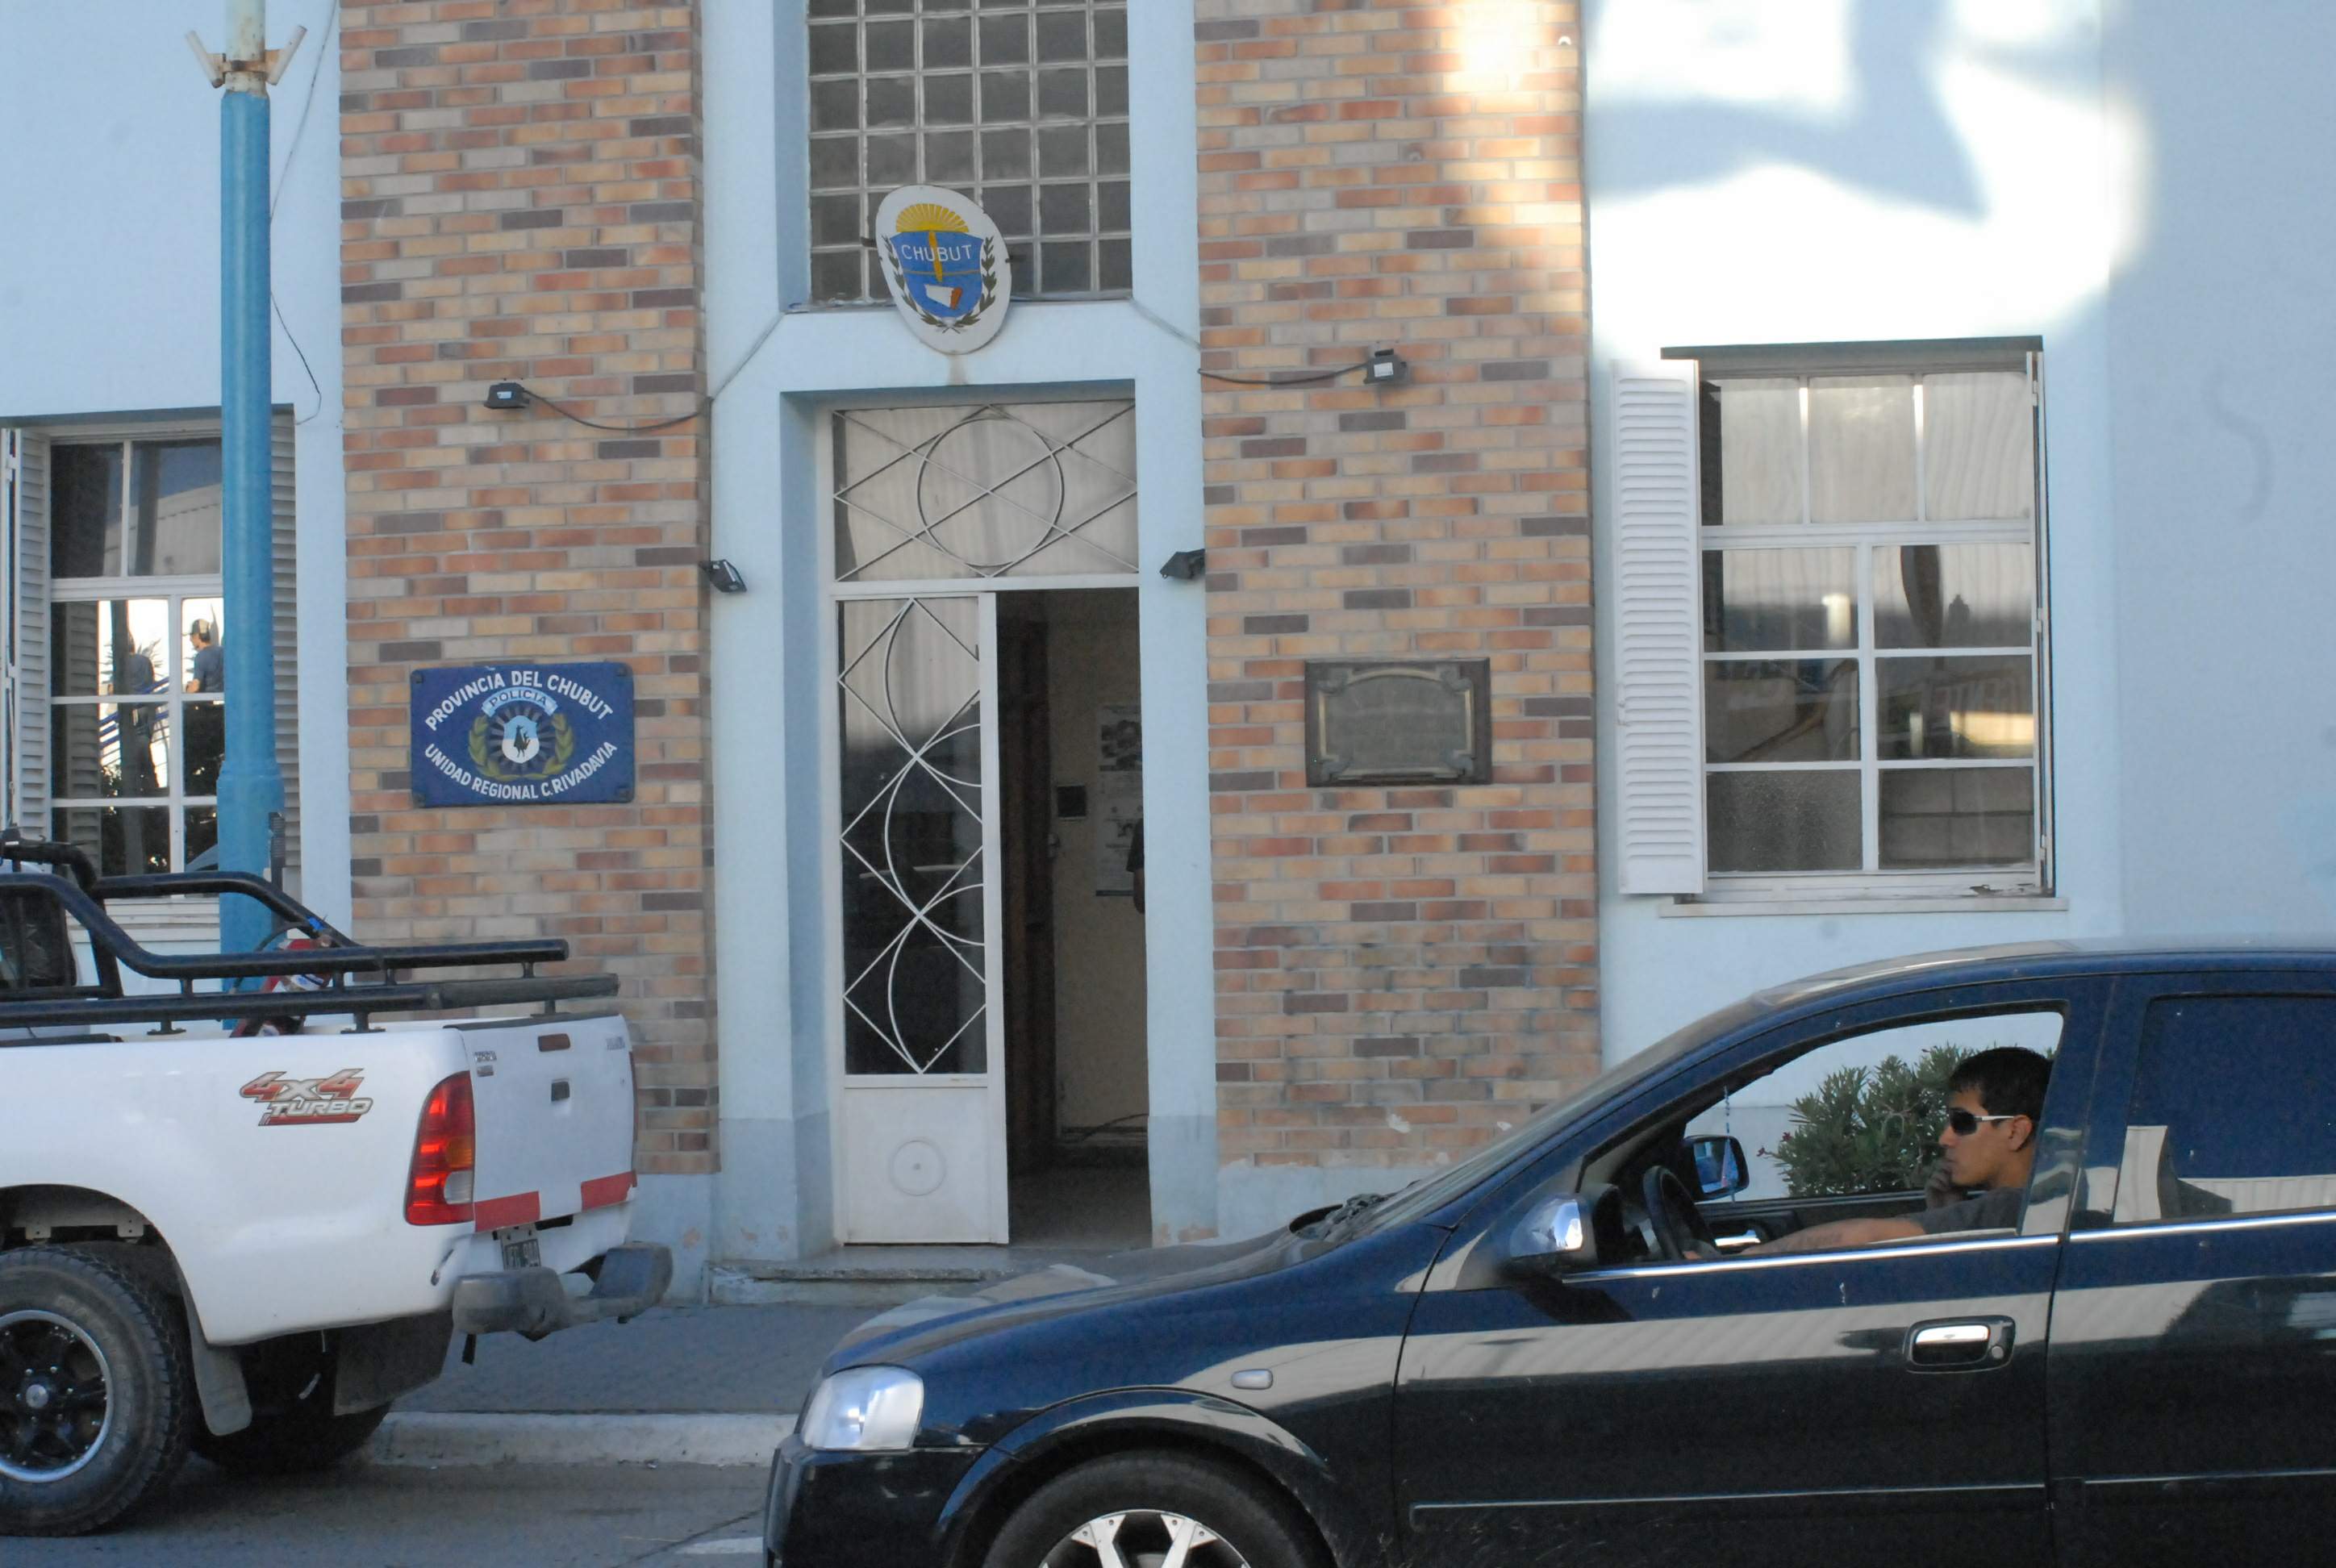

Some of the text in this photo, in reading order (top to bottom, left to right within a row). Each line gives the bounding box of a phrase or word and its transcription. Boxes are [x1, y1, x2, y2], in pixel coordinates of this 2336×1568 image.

[901, 244, 971, 261] CHUBUT
[425, 671, 613, 731] PROVINCIA DEL CHUBUT
[490, 690, 546, 707] POLICIA
[424, 744, 471, 786] UNIDAD
[472, 778, 539, 799] REGIONAL
[268, 1099, 373, 1117] TURBO
